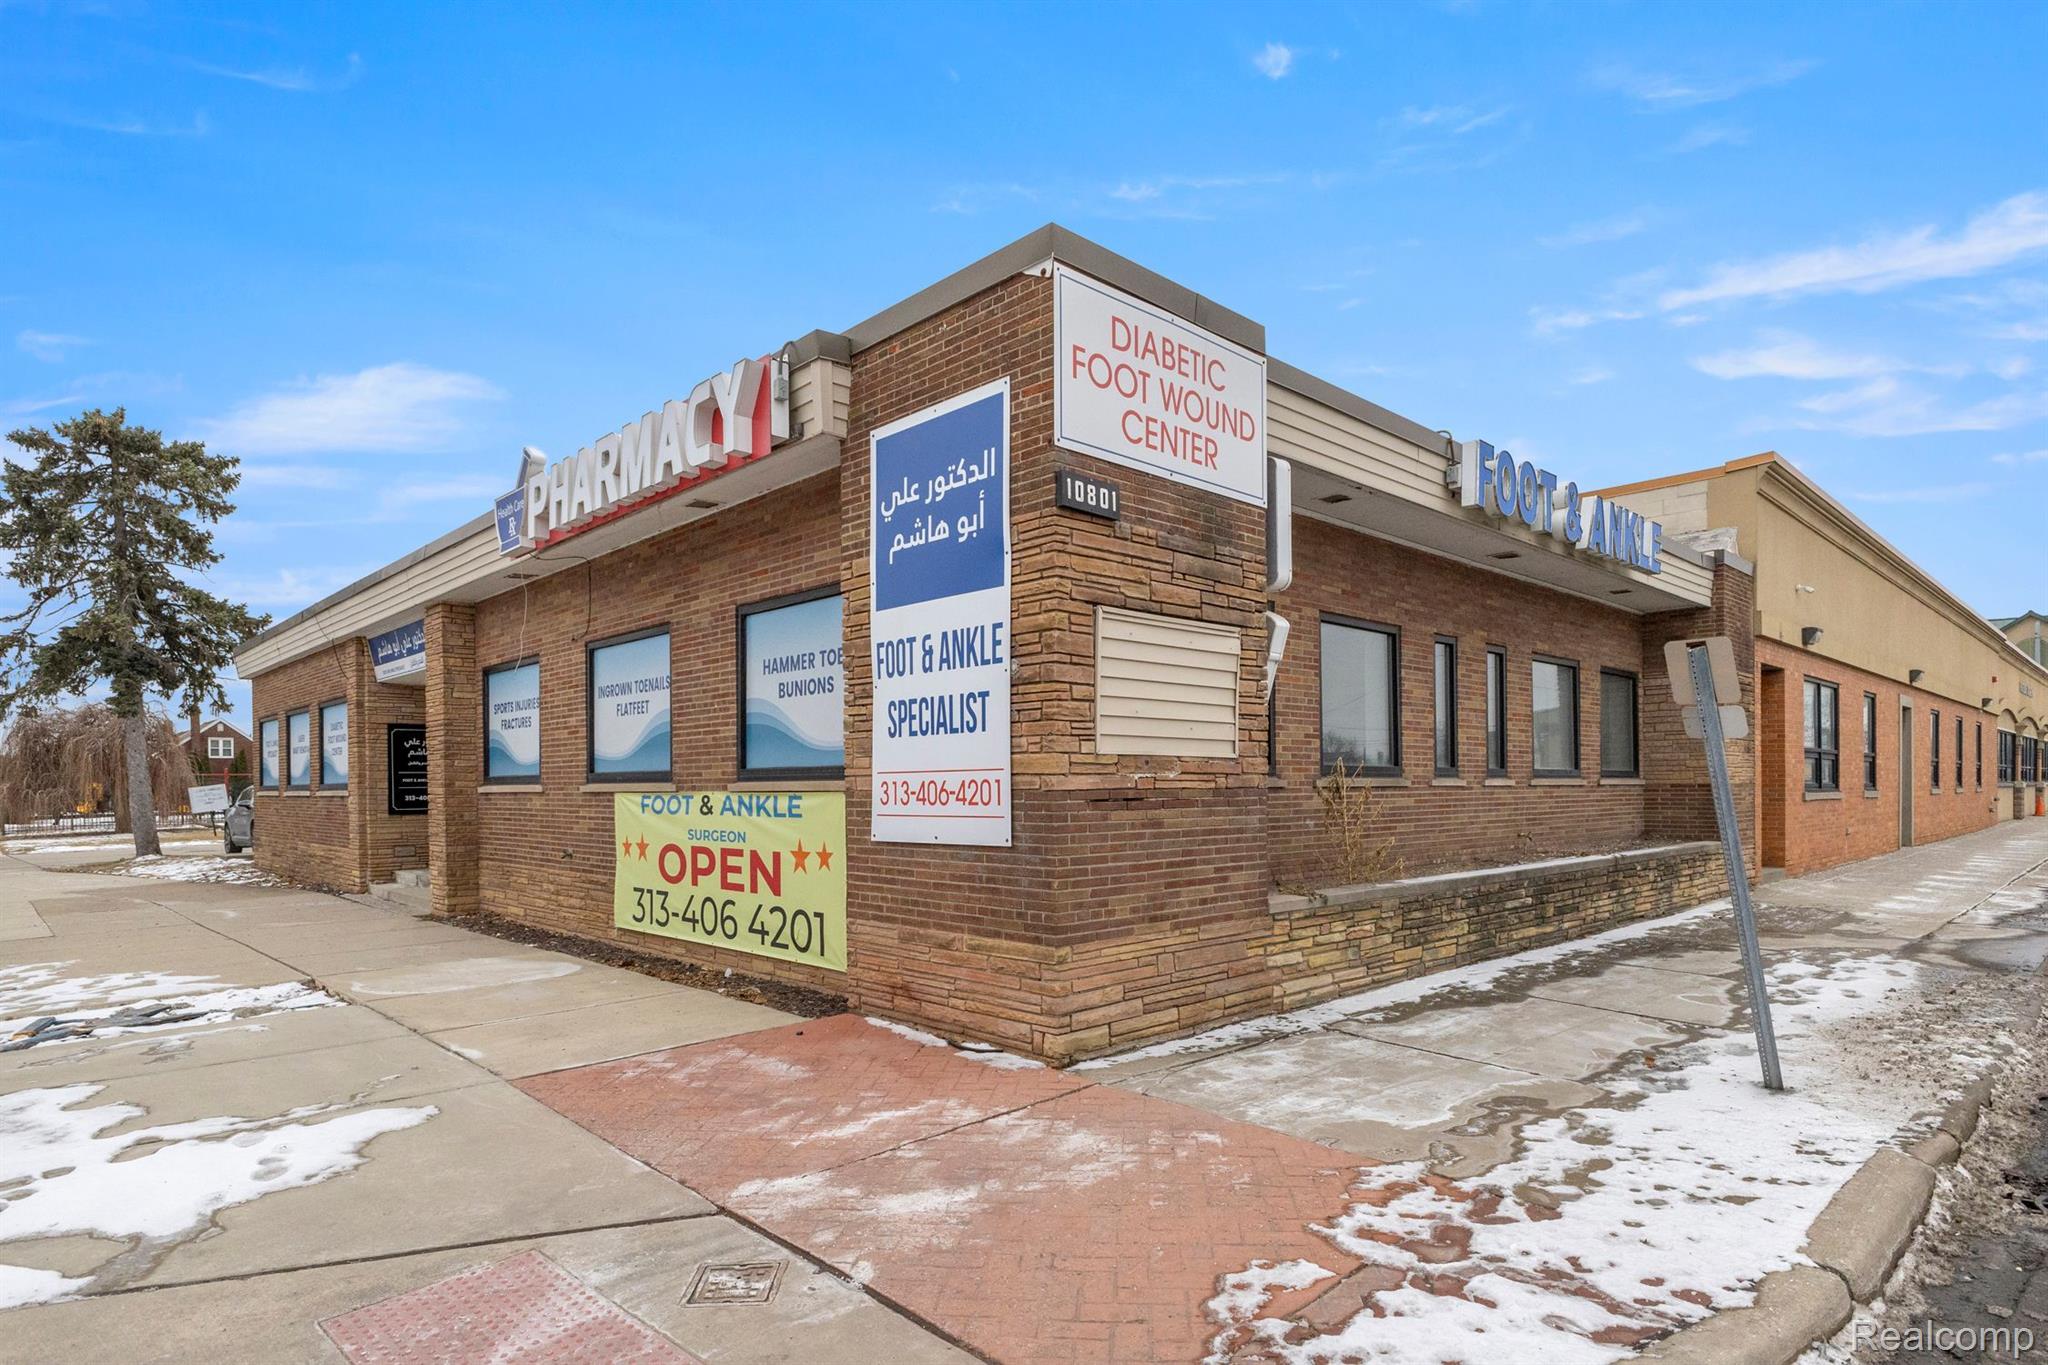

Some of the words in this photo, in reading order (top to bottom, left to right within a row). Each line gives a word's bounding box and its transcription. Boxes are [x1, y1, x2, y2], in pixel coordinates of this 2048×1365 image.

[1111, 315, 1226, 392] DIABETIC
[1072, 344, 1151, 404] FOOT
[1159, 377, 1255, 442] WOUND
[528, 358, 764, 541] PHARMACY
[1121, 409, 1218, 470] CENTER
[925, 447, 995, 504] الدكتور
[1066, 478, 1117, 511] 10801
[497, 502, 514, 520] Health
[881, 477, 920, 522] علي
[957, 490, 985, 543] أبو
[1464, 439, 1557, 534] FOOT
[1558, 482, 1582, 544] &
[1578, 495, 1662, 574] ANKLE
[889, 515, 949, 565] هاشم
[763, 652, 816, 675] HAMMER
[876, 636, 917, 680] FOOT
[922, 633, 934, 674] &
[938, 622, 1004, 671] ANKLE
[493, 701, 514, 715] SPORTS
[597, 681, 633, 699] INGROWN
[634, 675, 671, 694] TOENAILS
[616, 700, 650, 717] FLATFEET
[778, 675, 834, 699] BUNIONS
[500, 716, 532, 731] FRACTURES
[888, 690, 990, 739] SPECIALIST
[641, 795, 694, 816] FOOT
[699, 795, 713, 815] &
[720, 794, 803, 818] ANKLE
[879, 778, 1001, 806] 313-406-4201
[687, 829, 746, 843] SURGEON
[658, 843, 781, 897] OPEN
[632, 886, 738, 940] 313-406
[748, 904, 825, 957] 4201
